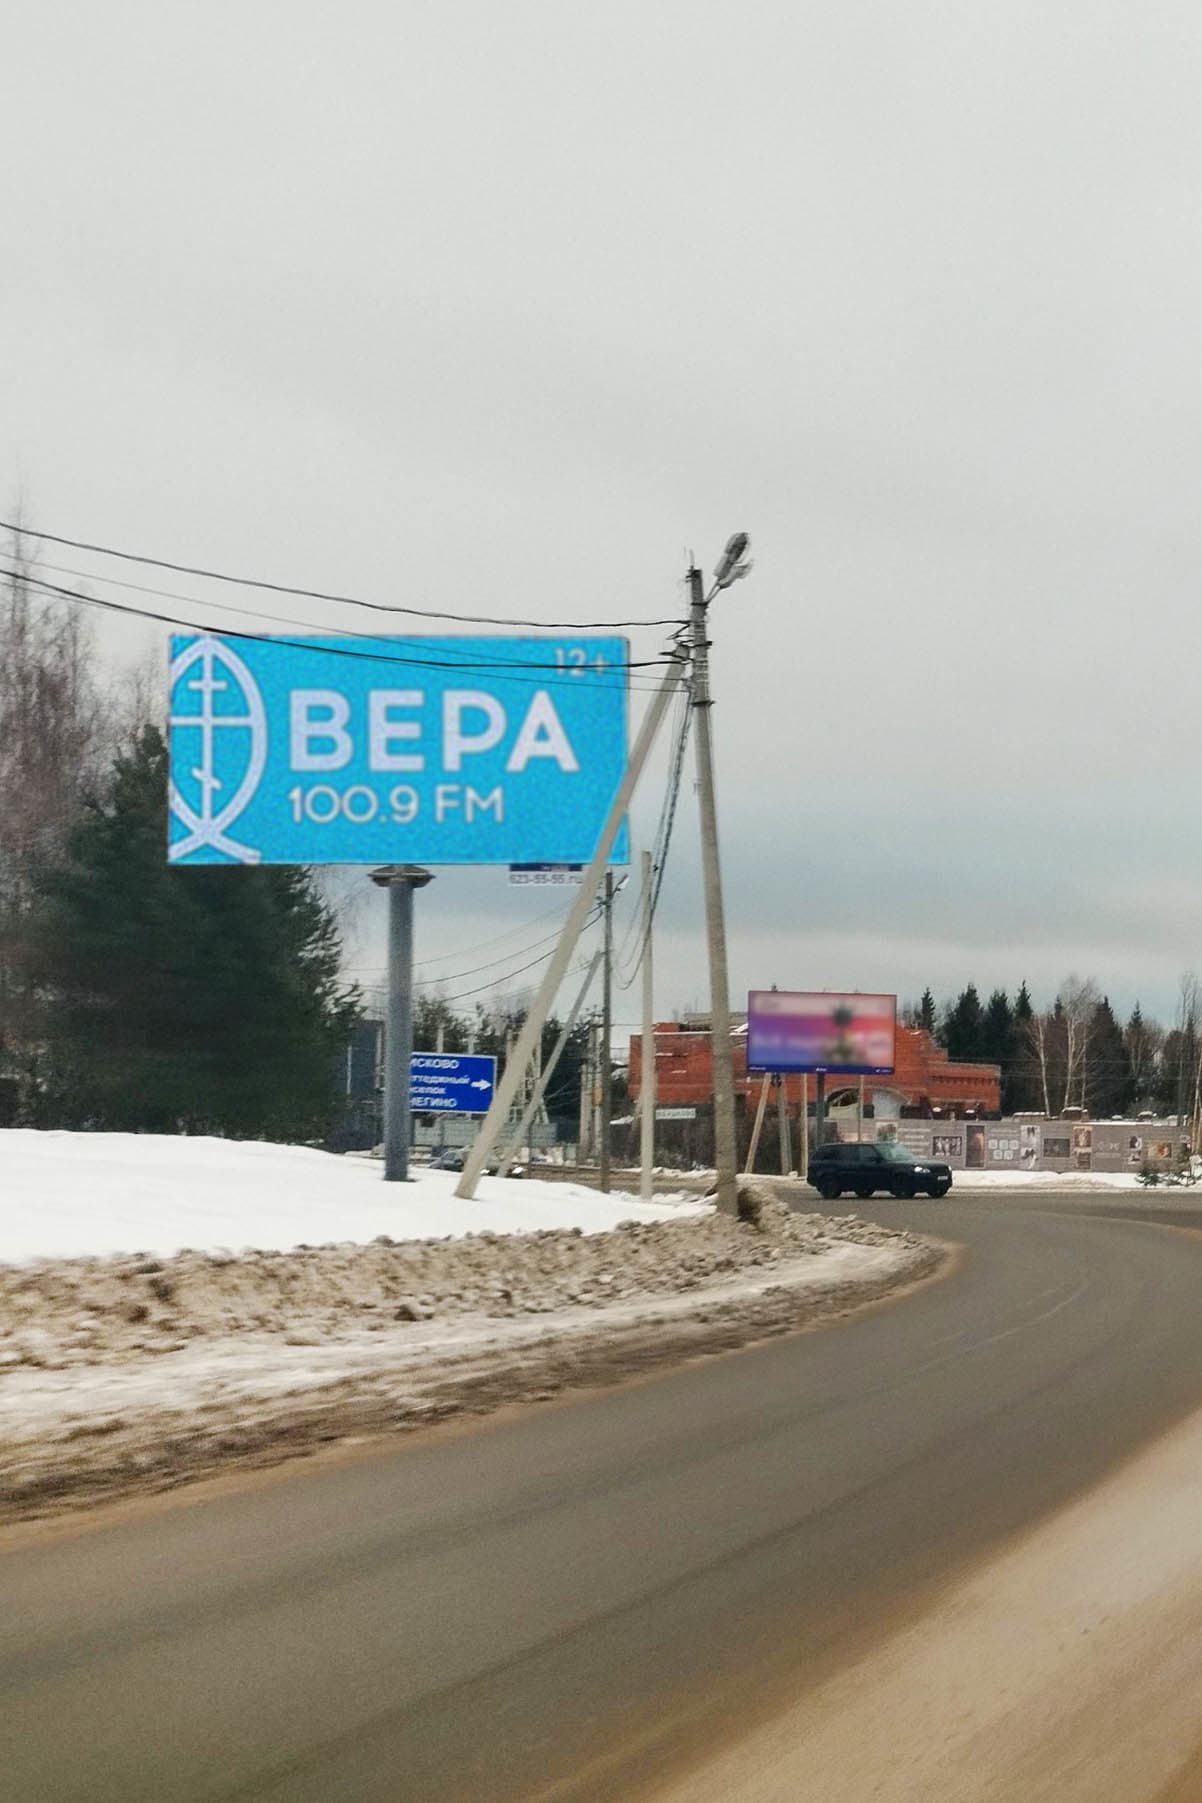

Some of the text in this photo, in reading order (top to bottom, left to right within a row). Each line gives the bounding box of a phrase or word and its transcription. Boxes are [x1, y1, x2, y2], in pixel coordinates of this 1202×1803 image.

[555, 647, 610, 677] 12+
[288, 689, 580, 773] ВЕРА
[287, 784, 504, 824] 100.9 FM
